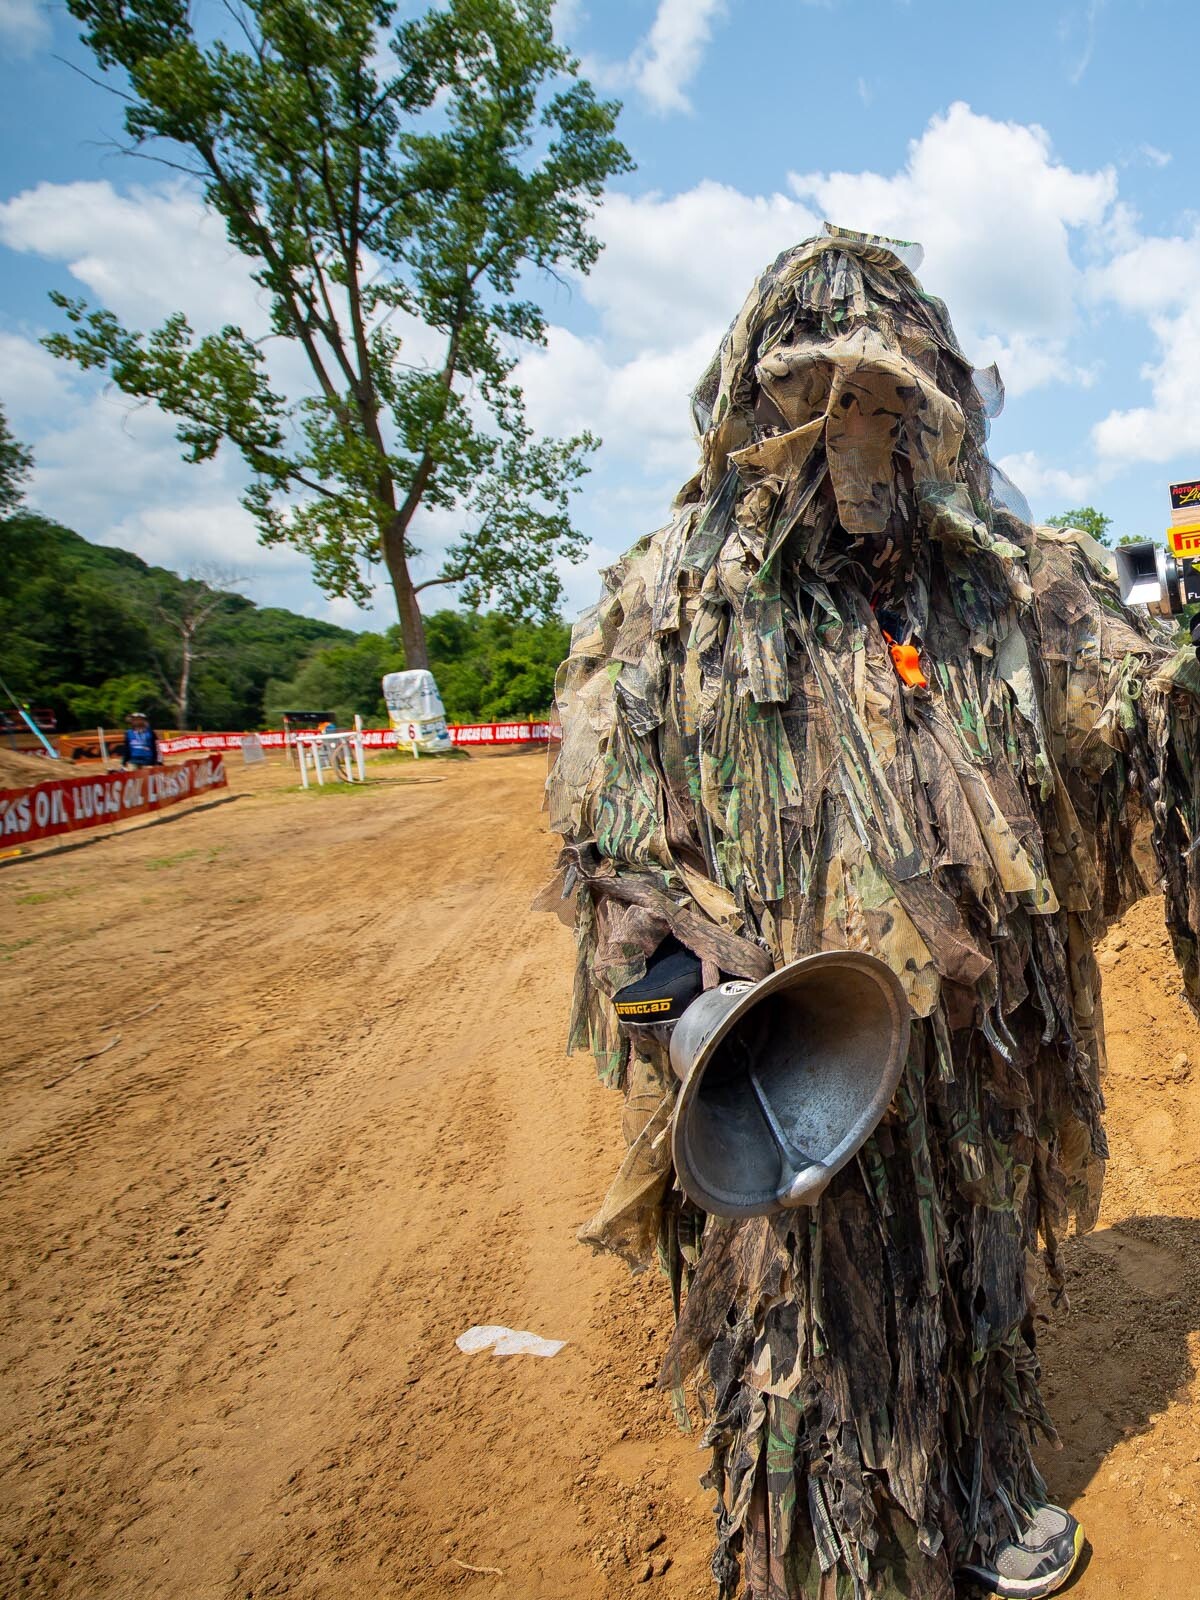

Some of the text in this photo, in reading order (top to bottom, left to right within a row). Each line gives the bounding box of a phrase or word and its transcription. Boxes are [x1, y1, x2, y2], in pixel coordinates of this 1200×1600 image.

[408, 724, 415, 740] 6
[457, 727, 481, 741] LUCAS
[481, 726, 494, 740] OIL
[496, 725, 519, 739] LUCAS
[519, 725, 531, 738] OIL
[72, 781, 121, 819] LUCAS
